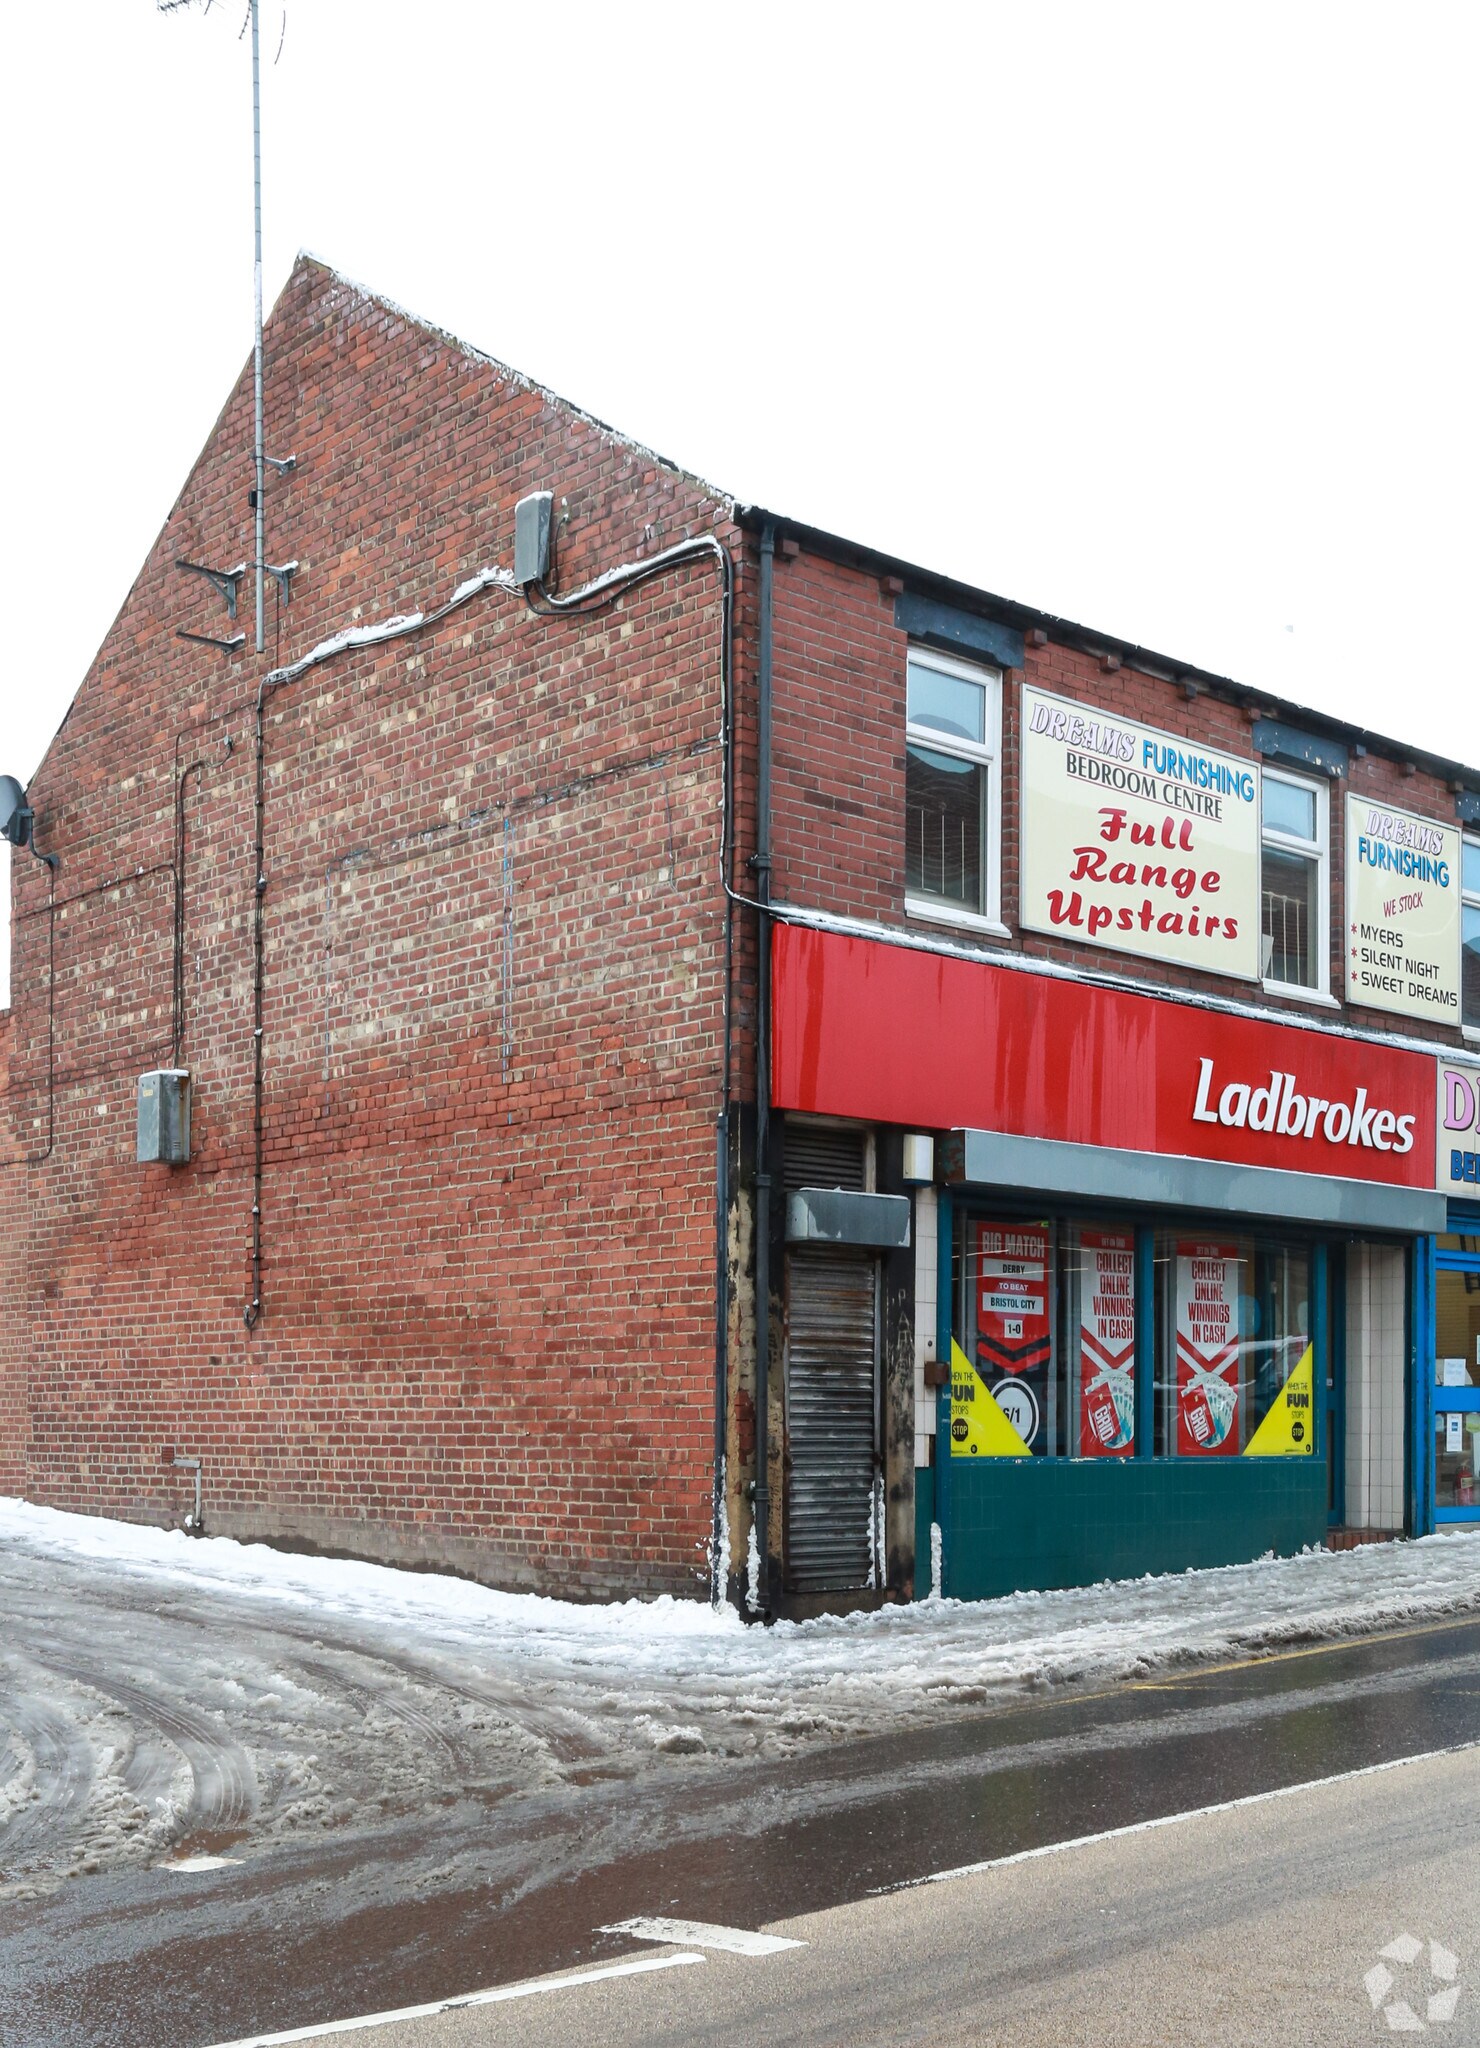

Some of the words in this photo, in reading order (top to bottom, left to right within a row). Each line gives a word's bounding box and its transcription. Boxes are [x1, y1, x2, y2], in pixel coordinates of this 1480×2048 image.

[1029, 702, 1136, 763] DREAMS
[1142, 739, 1255, 802] FURNISHING
[1066, 752, 1157, 800] BEDROOM
[1163, 783, 1222, 820] CENTRE
[1098, 807, 1194, 851] Full
[1365, 809, 1444, 856] DREAMS
[1069, 846, 1221, 899] Range
[1358, 836, 1450, 888] FURNISHING
[1046, 889, 1239, 940] Upstairs
[1383, 899, 1396, 918] WE
[1399, 891, 1423, 913] STOCK
[1360, 923, 1404, 948] MYERS
[1361, 947, 1402, 971] SILENT
[1405, 958, 1440, 980] NIGHT
[1361, 971, 1404, 995] SWEET
[1408, 982, 1458, 1007] DREAMS
[1192, 1056, 1417, 1154] Ladbrokes
[982, 1231, 1002, 1253] BIG
[1005, 1234, 1045, 1259] MATCH
[1002, 1263, 1026, 1275] DERBY
[1096, 1252, 1133, 1274] COLLECT
[1191, 1260, 1226, 1281] COLLECT
[999, 1282, 1009, 1290] TO
[1010, 1282, 1029, 1292] BEAT
[1100, 1274, 1130, 1296] ONLINE
[1194, 1281, 1224, 1303] ONLINE
[990, 1296, 1019, 1309] BRISTOL
[1020, 1299, 1036, 1310] CITY
[1188, 1302, 1230, 1323] WINNINGS
[1007, 1323, 1021, 1335] 1-0
[1097, 1319, 1107, 1338] IN
[1109, 1319, 1133, 1340] CASH
[1192, 1324, 1201, 1343] IN
[1203, 1325, 1226, 1344] CASH
[951, 1371, 963, 1382] HEN
[964, 1372, 974, 1382] THE
[1288, 1382, 1300, 1390] WHEN
[951, 1385, 975, 1402] UN
[1287, 1393, 1309, 1408] FUN
[951, 1405, 969, 1415] STOPS
[1292, 1411, 1305, 1419] STOPS
[952, 1425, 968, 1436] STOP
[1095, 1404, 1114, 1442] GRID
[1190, 1406, 1209, 1441] GRID
[1292, 1428, 1304, 1437] STOP
